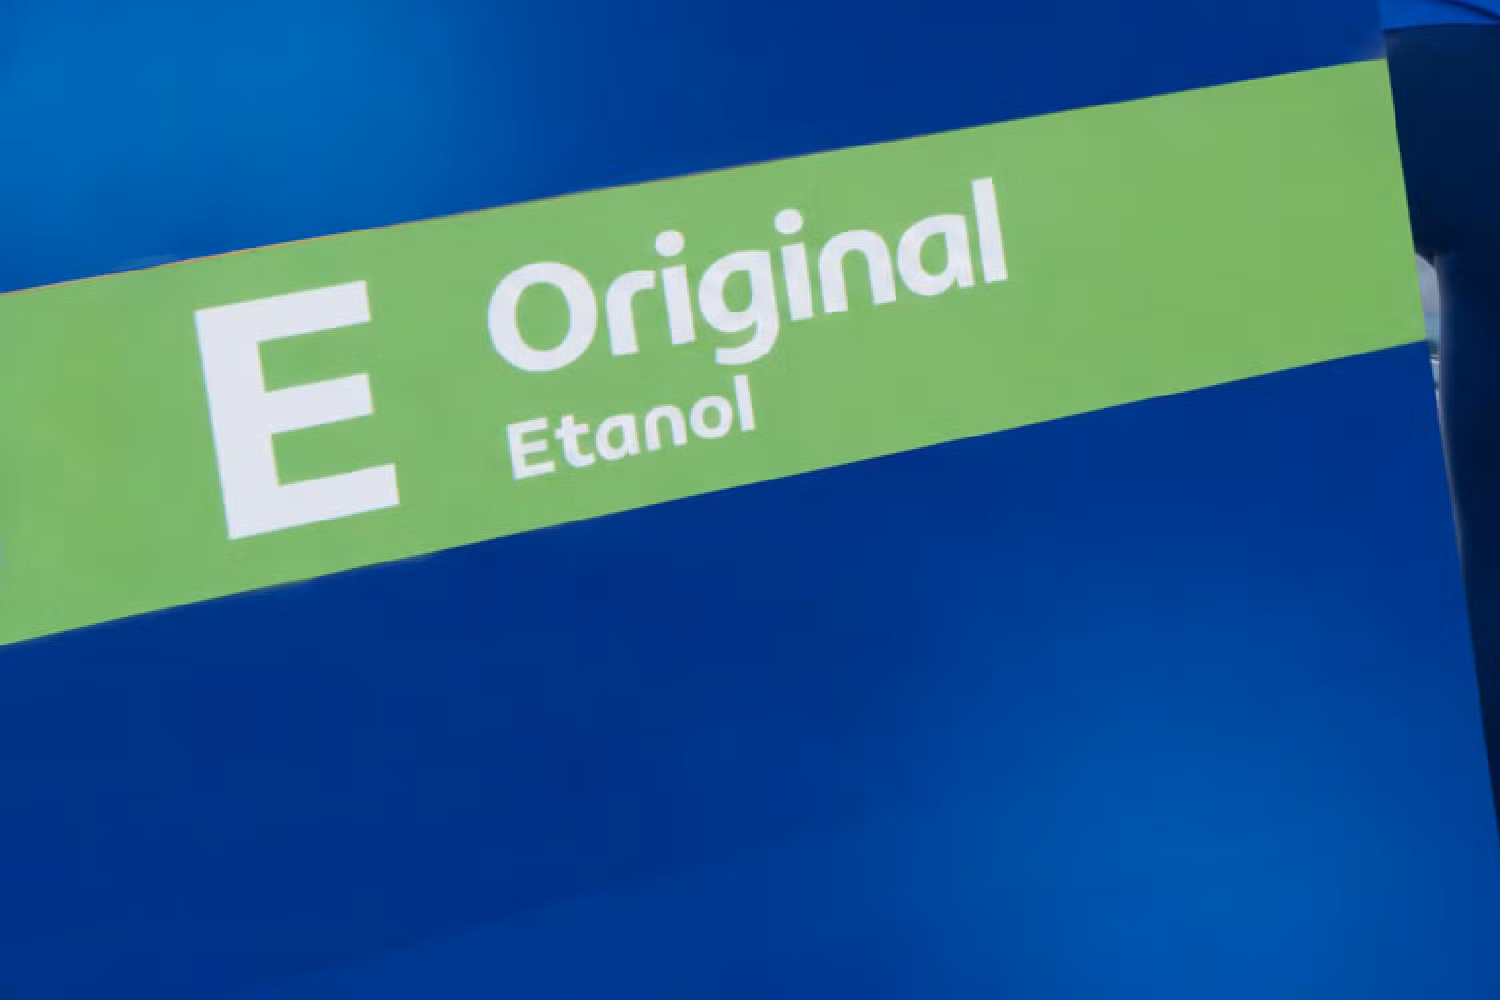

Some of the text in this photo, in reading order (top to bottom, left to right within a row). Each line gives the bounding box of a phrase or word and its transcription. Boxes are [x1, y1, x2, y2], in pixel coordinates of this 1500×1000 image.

[486, 176, 1010, 367] Original
[193, 279, 401, 541] E
[504, 374, 756, 482] Etanol
